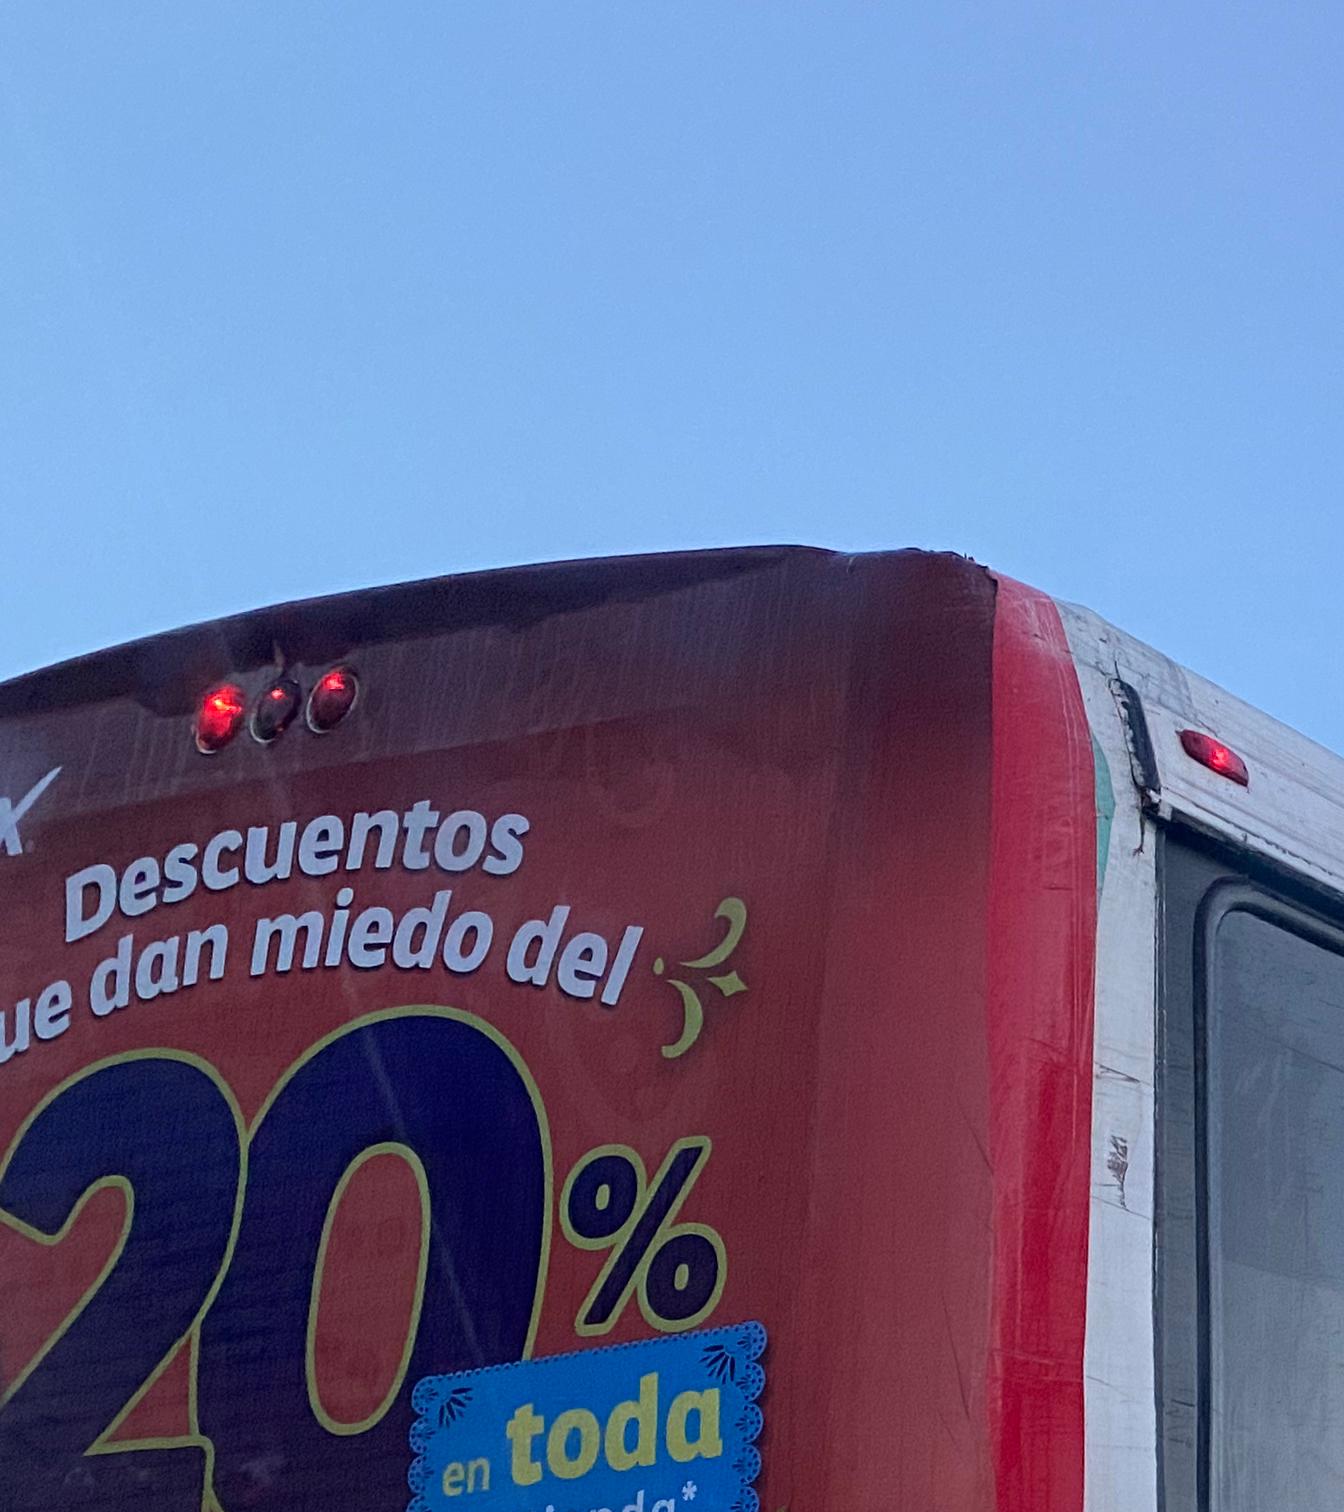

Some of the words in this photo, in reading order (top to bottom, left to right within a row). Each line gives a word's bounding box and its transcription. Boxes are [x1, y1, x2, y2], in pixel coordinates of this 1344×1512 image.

[65, 800, 531, 942] Descuentos
[90, 923, 229, 1016] dan
[250, 889, 493, 976] miedo
[505, 905, 644, 1005] del
[441, 1457, 491, 1497] en
[505, 1371, 723, 1486] toda
